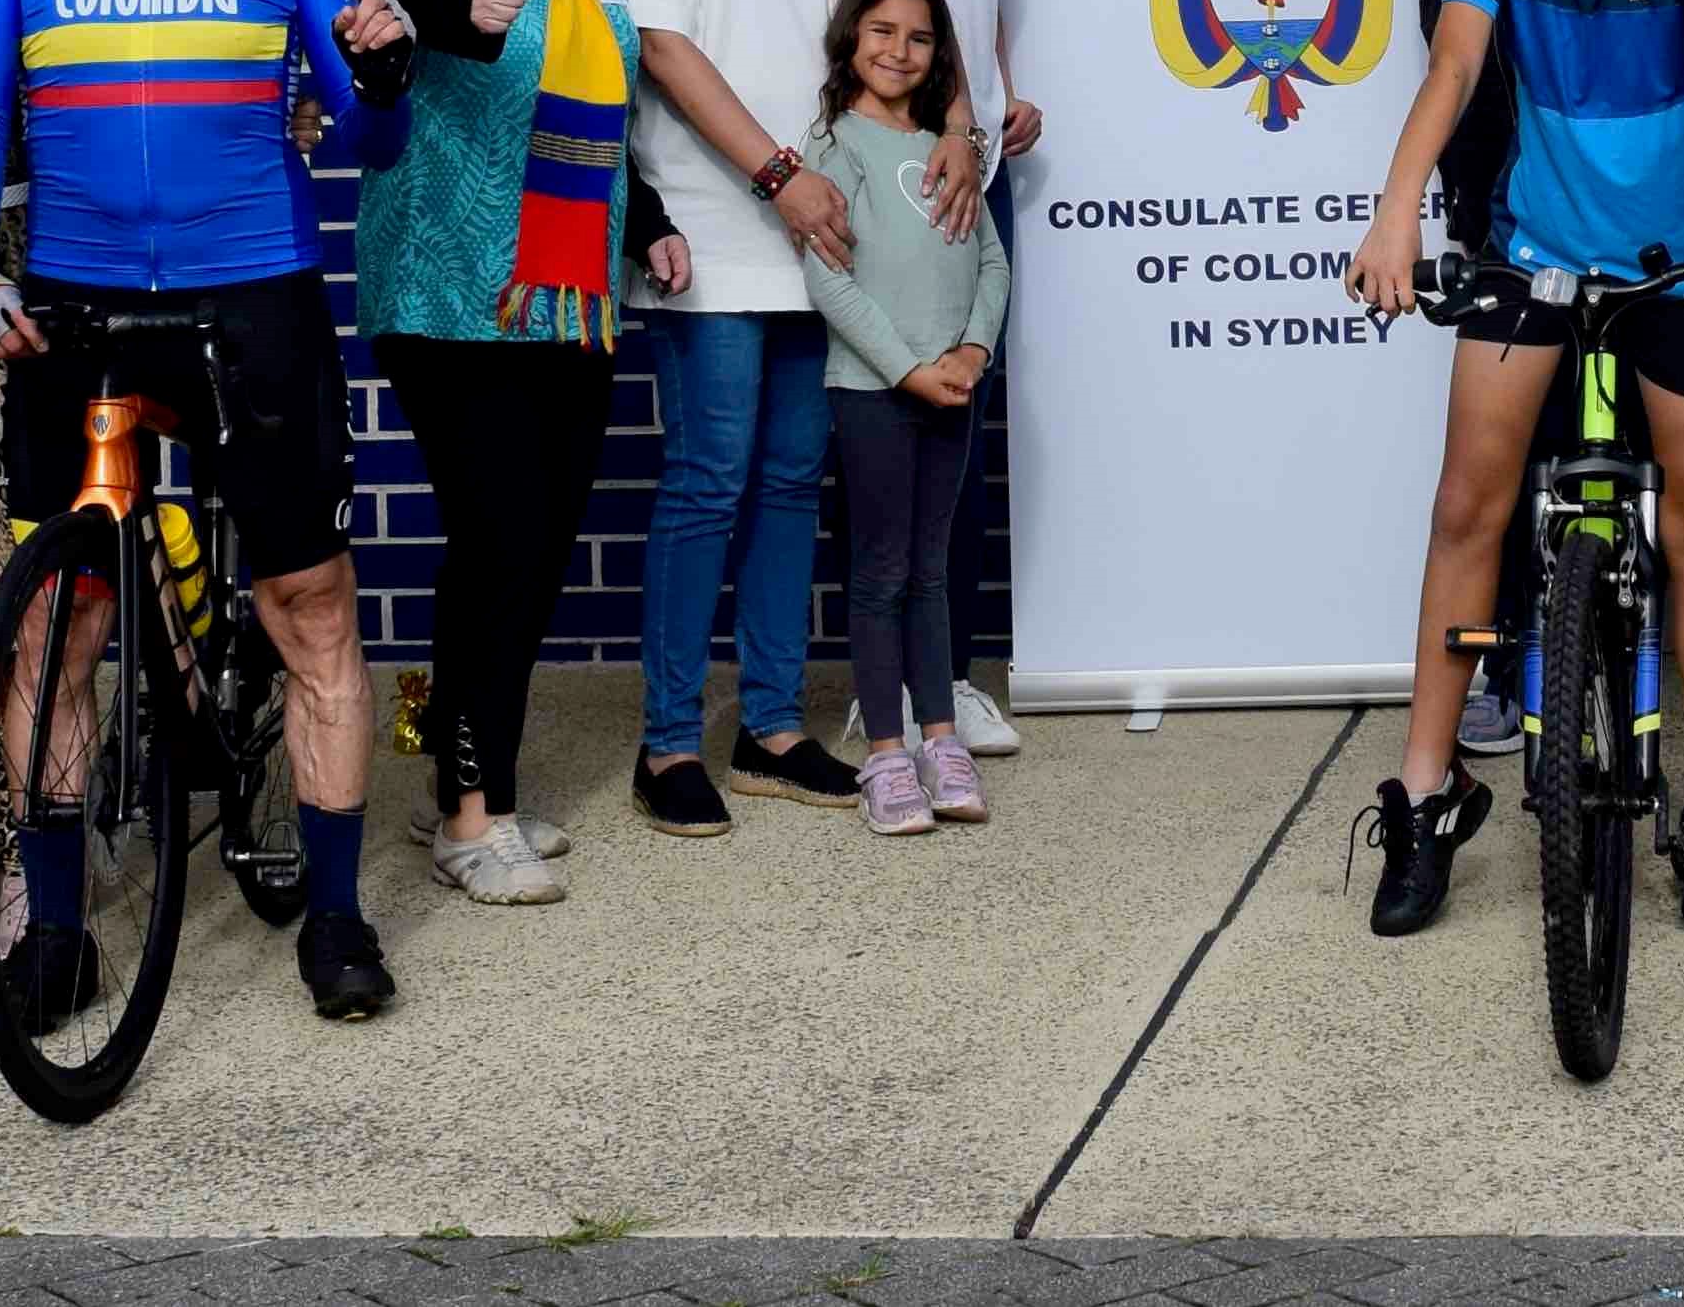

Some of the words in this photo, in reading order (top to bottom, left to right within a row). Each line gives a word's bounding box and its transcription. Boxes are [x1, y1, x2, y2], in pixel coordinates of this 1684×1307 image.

[1048, 196, 1301, 230] CONSULATE
[1136, 255, 1190, 284] OF
[1204, 251, 1351, 282] COLOM
[1170, 320, 1212, 348] IN
[1227, 315, 1393, 348] SYDNEY
